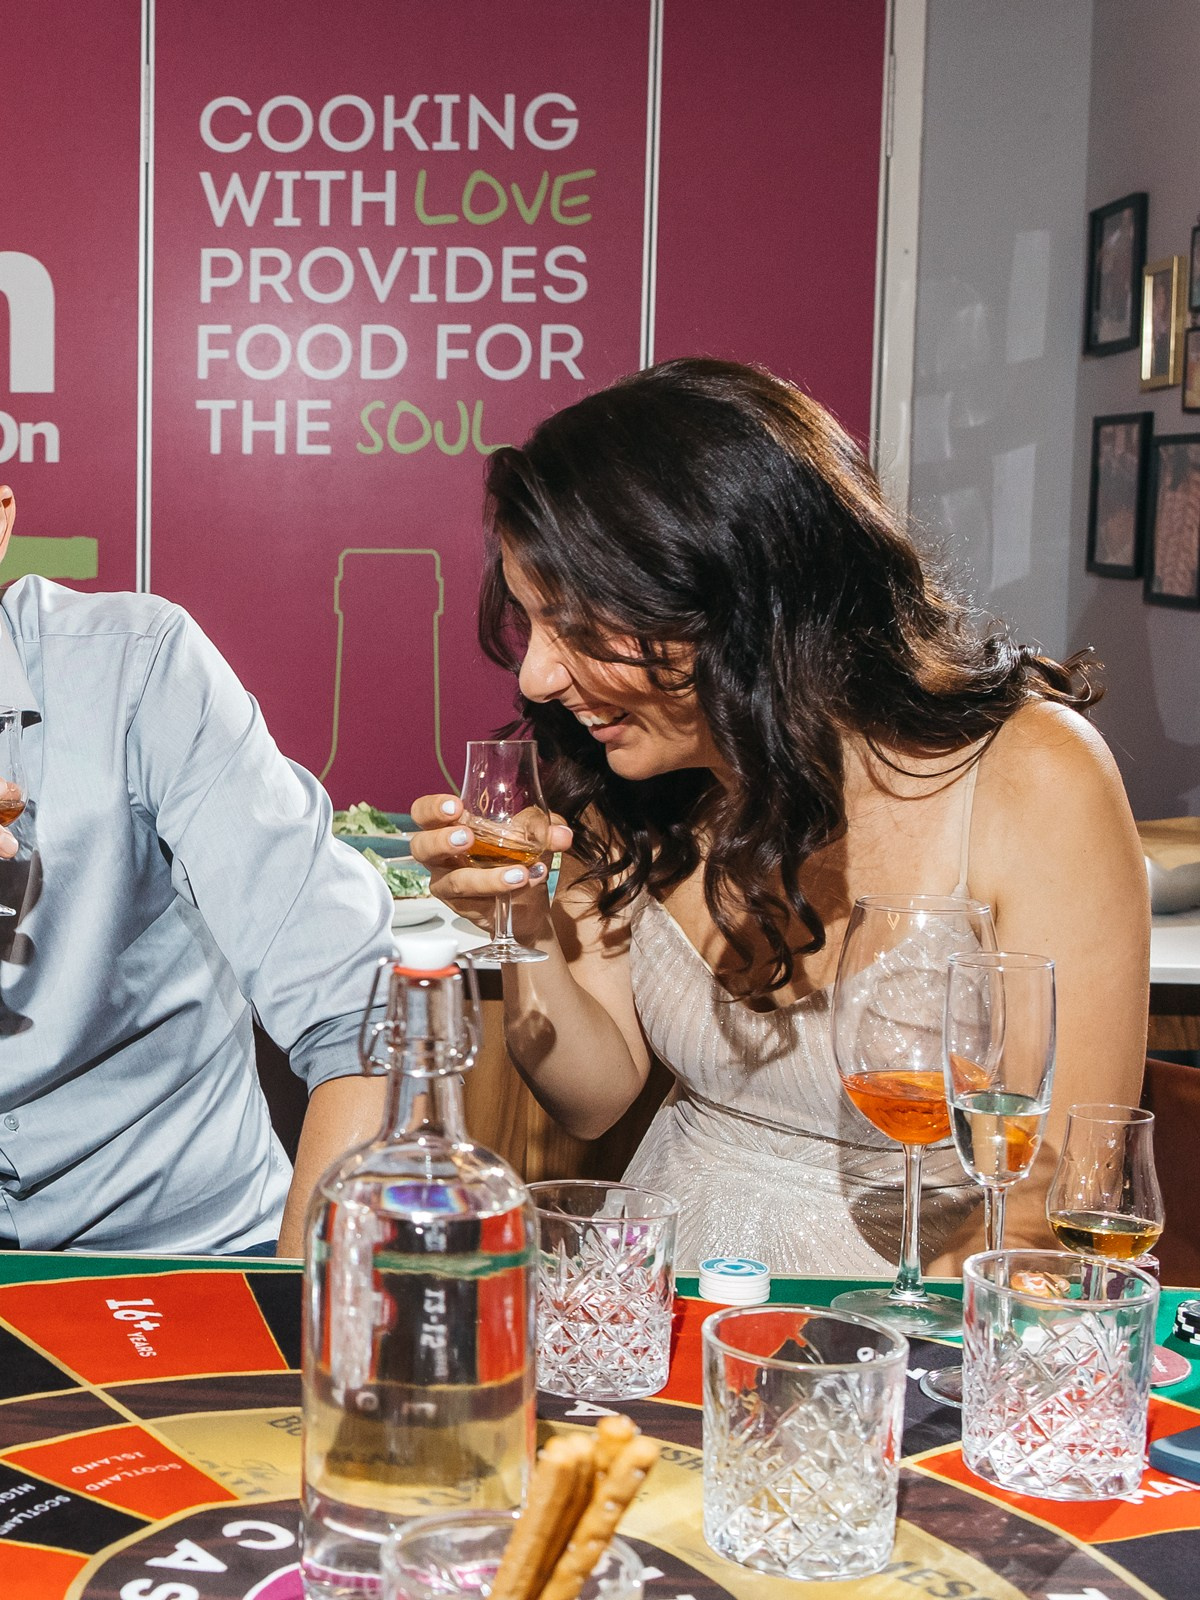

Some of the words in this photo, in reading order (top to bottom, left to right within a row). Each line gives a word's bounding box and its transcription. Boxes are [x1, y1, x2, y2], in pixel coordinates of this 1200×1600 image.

[199, 92, 580, 153] COOKING
[199, 170, 398, 228] WITH
[414, 168, 597, 226] LOVE
[200, 245, 590, 304] PROVIDES
[196, 323, 409, 382] FOOD
[436, 323, 586, 381] FOR
[195, 399, 333, 456] THE
[356, 399, 513, 456] SOUL
[104, 1297, 164, 1334] 16+
[126, 1330, 158, 1359] YEARS
[71, 1451, 146, 1474] ISLAND
[85, 1462, 182, 1492] SCOTLAND
